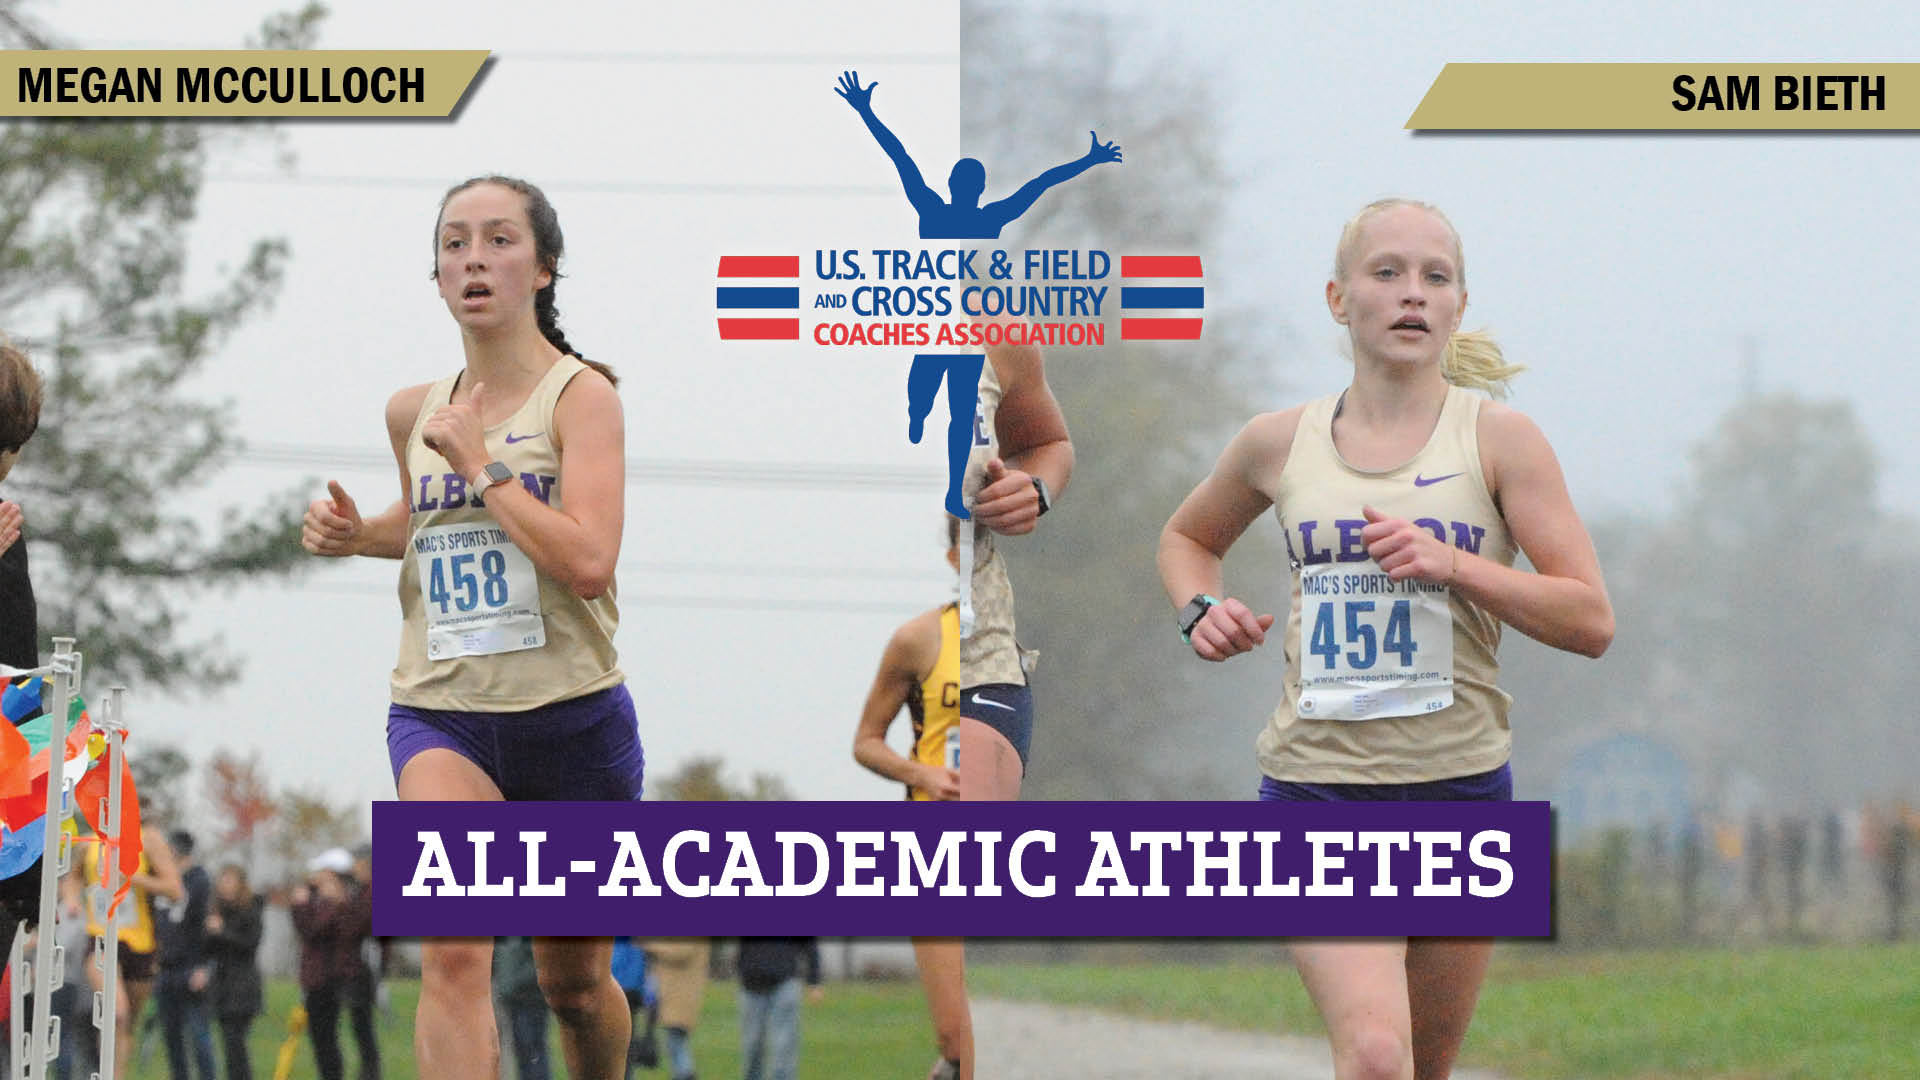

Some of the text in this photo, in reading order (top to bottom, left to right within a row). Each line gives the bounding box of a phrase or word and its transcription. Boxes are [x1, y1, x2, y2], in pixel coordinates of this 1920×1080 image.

[410, 472, 556, 513] LBN
[414, 534, 446, 554] MAC'S
[447, 529, 489, 550] SPORTS
[1284, 518, 1486, 569] LBN
[428, 550, 509, 614] 458
[1303, 575, 1340, 595] MAC'S
[1343, 575, 1395, 594] SPORTS
[522, 636, 538, 646] 458
[1309, 600, 1418, 670] 454
[1425, 701, 1444, 712] 454
